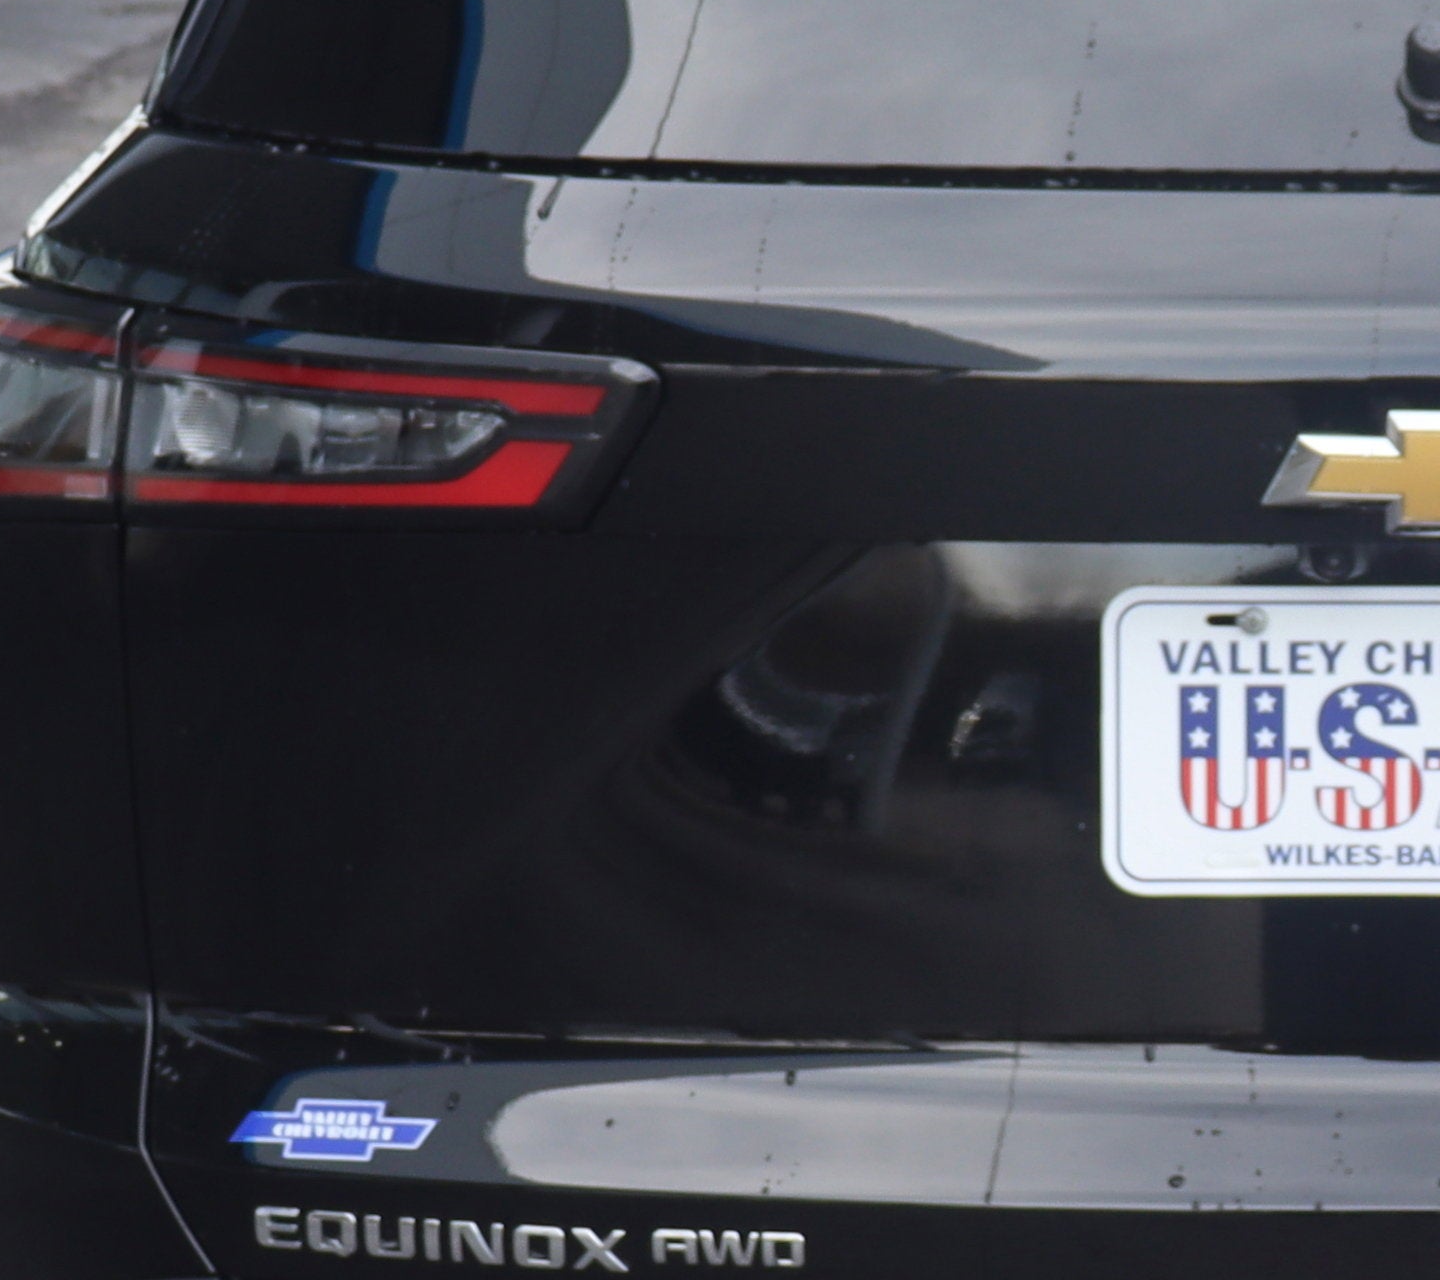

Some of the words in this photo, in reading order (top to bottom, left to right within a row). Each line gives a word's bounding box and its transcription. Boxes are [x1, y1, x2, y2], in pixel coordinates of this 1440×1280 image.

[1159, 641, 1347, 676] VALLEY
[271, 1123, 394, 1141] CHEVROLET
[254, 1205, 630, 1273] EQUINOX
[651, 1228, 807, 1268] AWD
